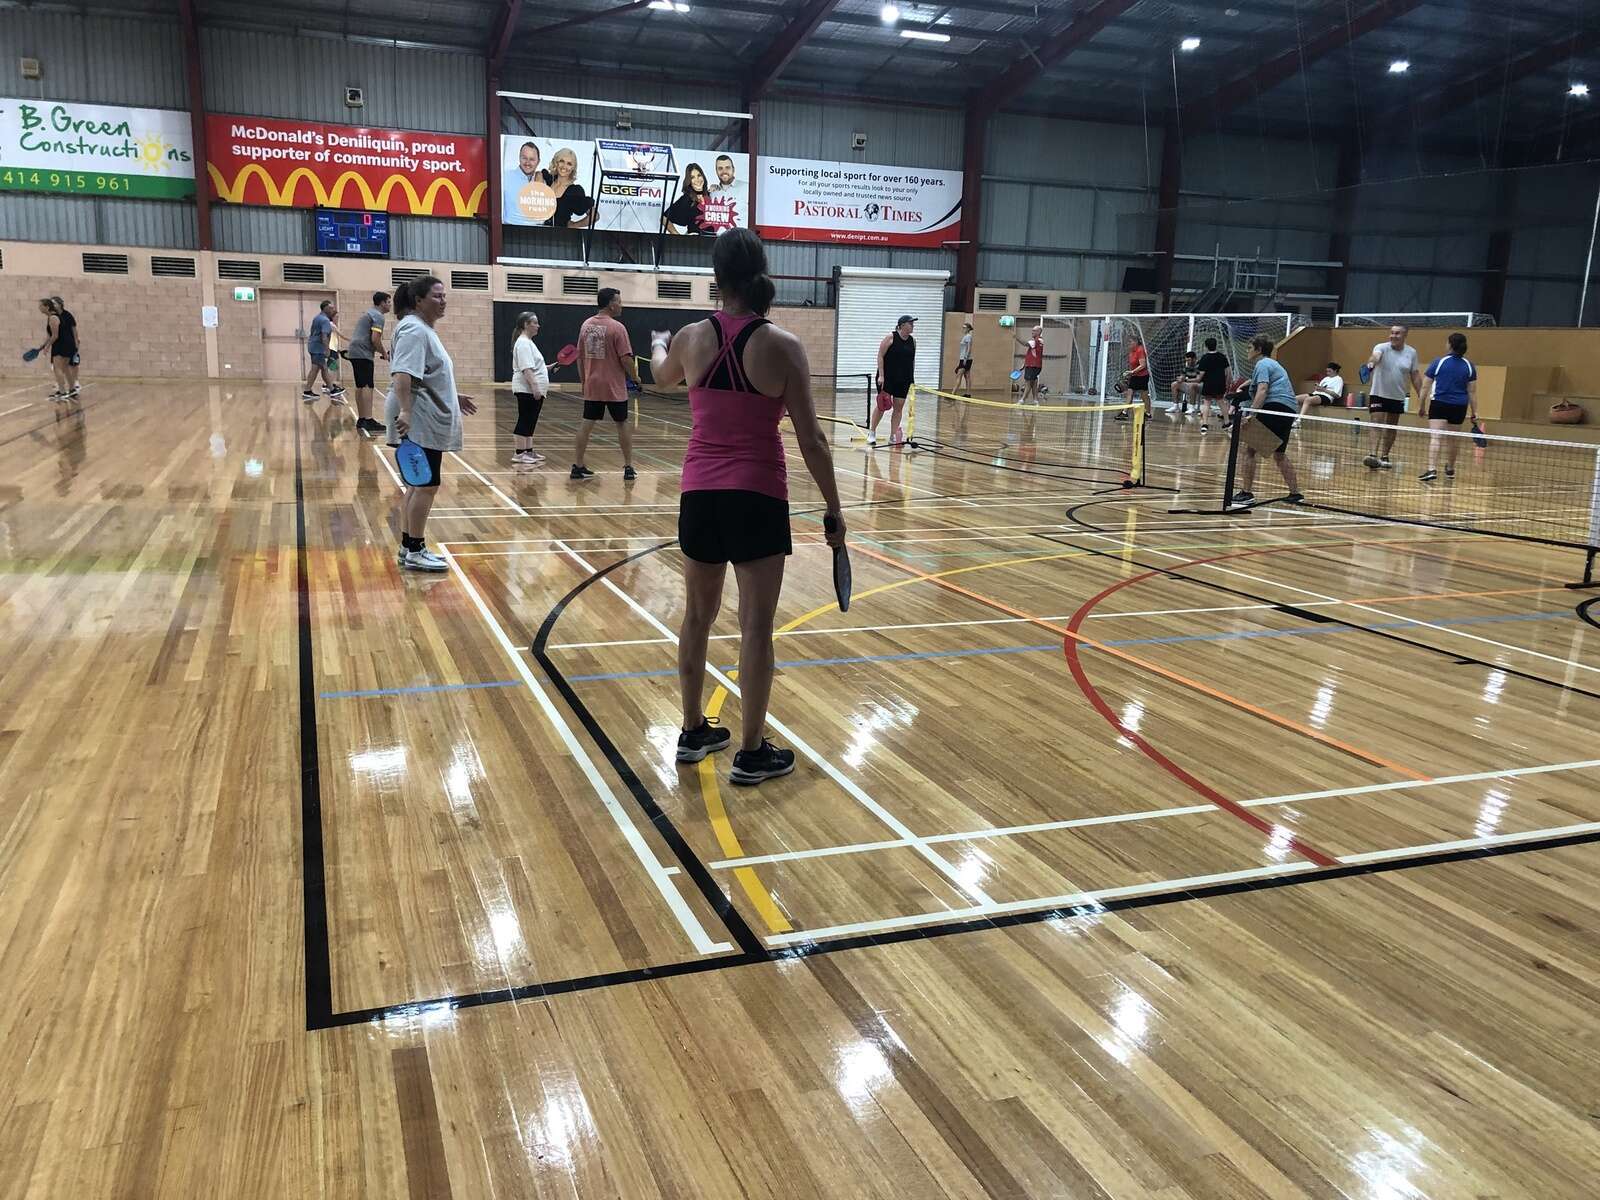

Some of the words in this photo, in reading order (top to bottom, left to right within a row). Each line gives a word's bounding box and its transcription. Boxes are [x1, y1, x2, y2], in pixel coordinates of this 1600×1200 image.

[51, 105, 131, 137] Green
[231, 124, 324, 145] McDonald's
[328, 133, 410, 153] Deniliquin,
[412, 142, 455, 155] proud
[232, 144, 311, 160] supporter
[314, 149, 331, 162] of
[333, 153, 420, 172] community
[422, 160, 466, 173] sport.
[3, 171, 40, 185] 414
[51, 173, 86, 188] 915
[96, 176, 130, 191] 961
[769, 165, 819, 179] Supporting
[820, 169, 842, 179] local
[844, 171, 867, 181] sport
[868, 173, 881, 182] for
[883, 175, 902, 183] over
[904, 176, 919, 184] 160
[920, 178, 946, 187] years.
[601, 185, 638, 196] EDGE
[640, 187, 662, 198] FM
[803, 188, 821, 197] locally
[705, 211, 730, 222] CREW
[794, 200, 863, 219] PASTORAL
[881, 206, 923, 222] TIMES
[830, 233, 889, 241] www.denipt.com.au
